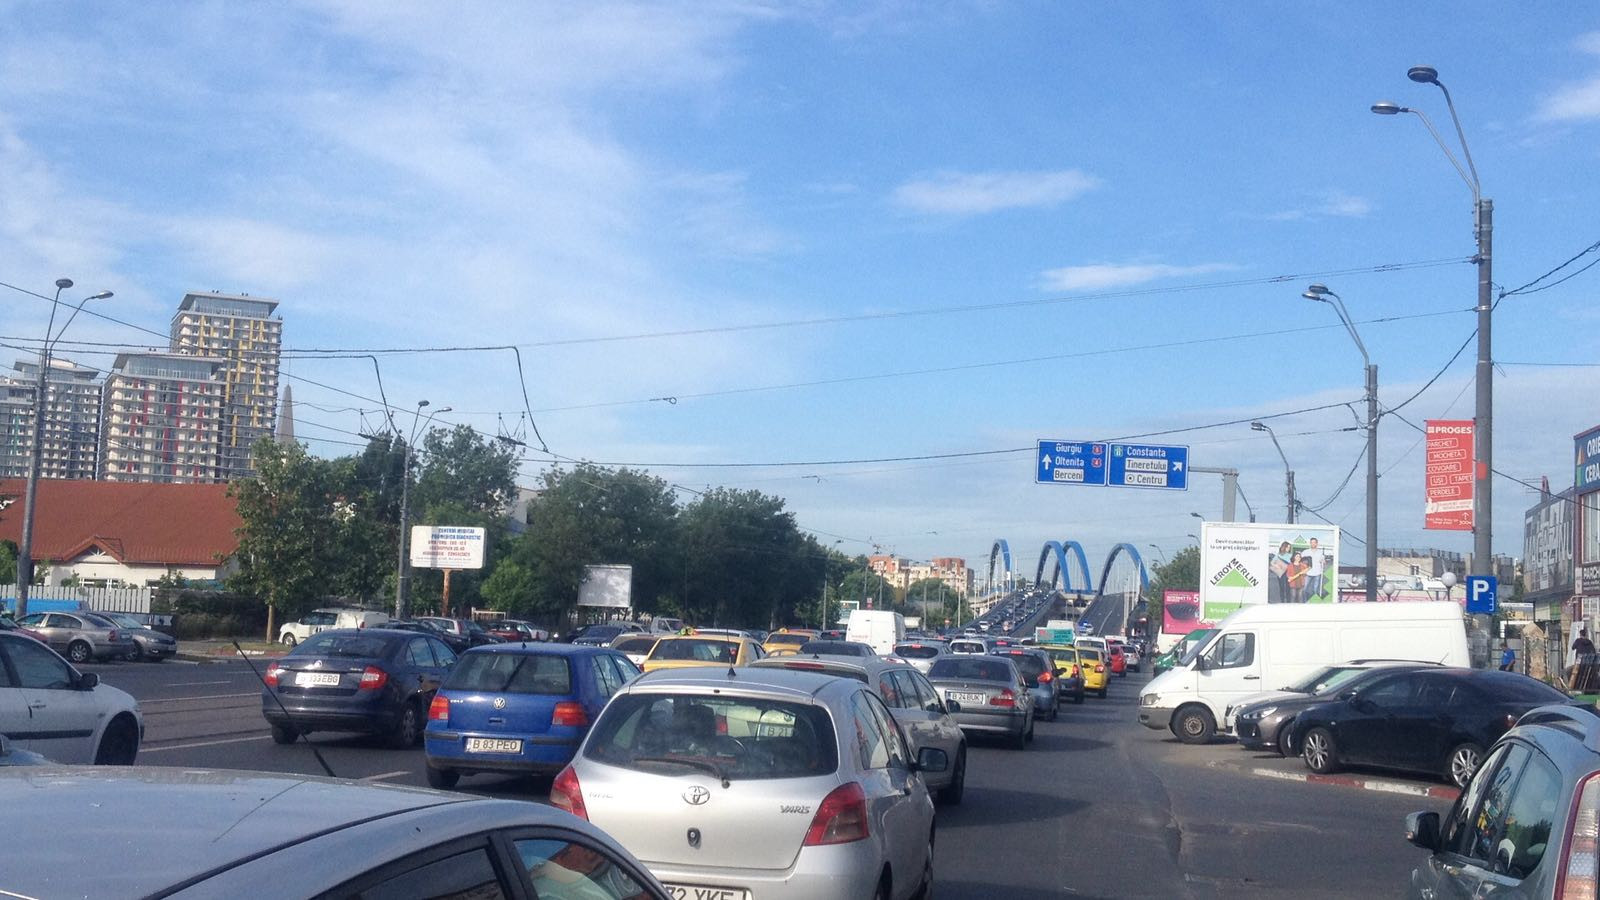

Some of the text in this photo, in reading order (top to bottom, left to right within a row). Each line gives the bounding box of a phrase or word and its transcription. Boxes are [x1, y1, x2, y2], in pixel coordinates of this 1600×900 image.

[1436, 426, 1472, 434] PROGES
[1056, 442, 1082, 455] Giurgiu
[1127, 459, 1168, 470] Tineretului
[1054, 470, 1083, 480] Berceni
[1137, 474, 1163, 484] Centru
[1210, 558, 1260, 587] LEROY MERLIN
[1473, 580, 1489, 601] P
[322, 675, 338, 683] EBG
[472, 740, 517, 751] B 83 PEO
[780, 805, 811, 815] YARIS
